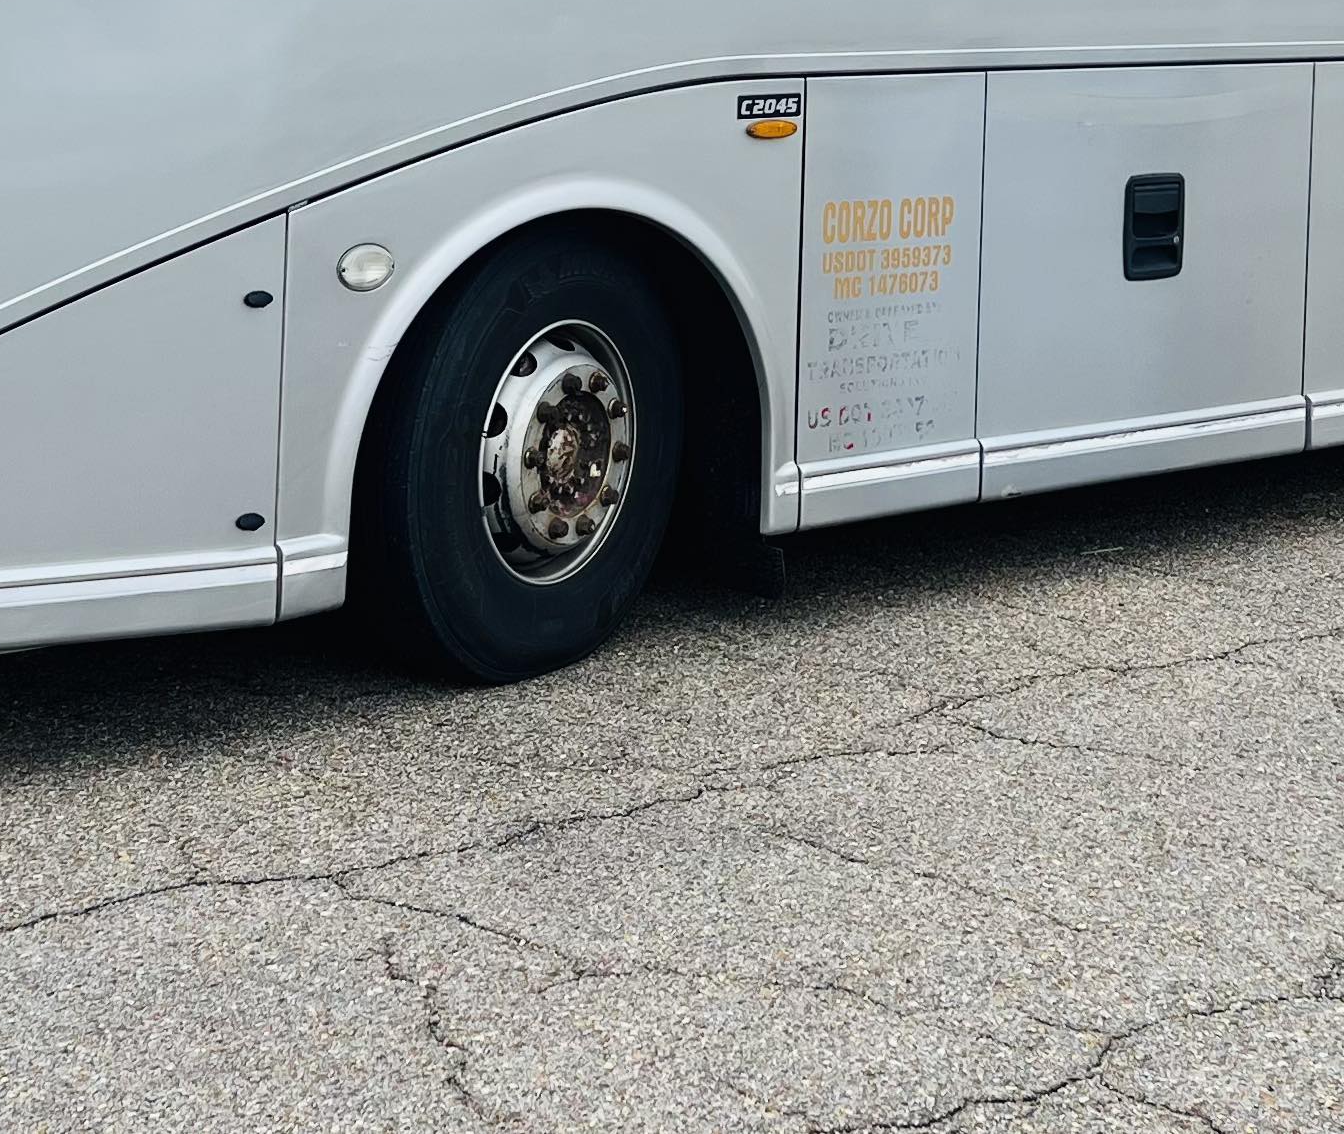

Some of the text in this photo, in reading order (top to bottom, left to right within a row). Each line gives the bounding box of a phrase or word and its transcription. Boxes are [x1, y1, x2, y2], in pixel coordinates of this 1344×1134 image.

[740, 97, 799, 116] C2045
[822, 196, 955, 245] CORZO CORP
[822, 244, 953, 274] USDOT 3959373
[833, 270, 940, 300] MC 1476073
